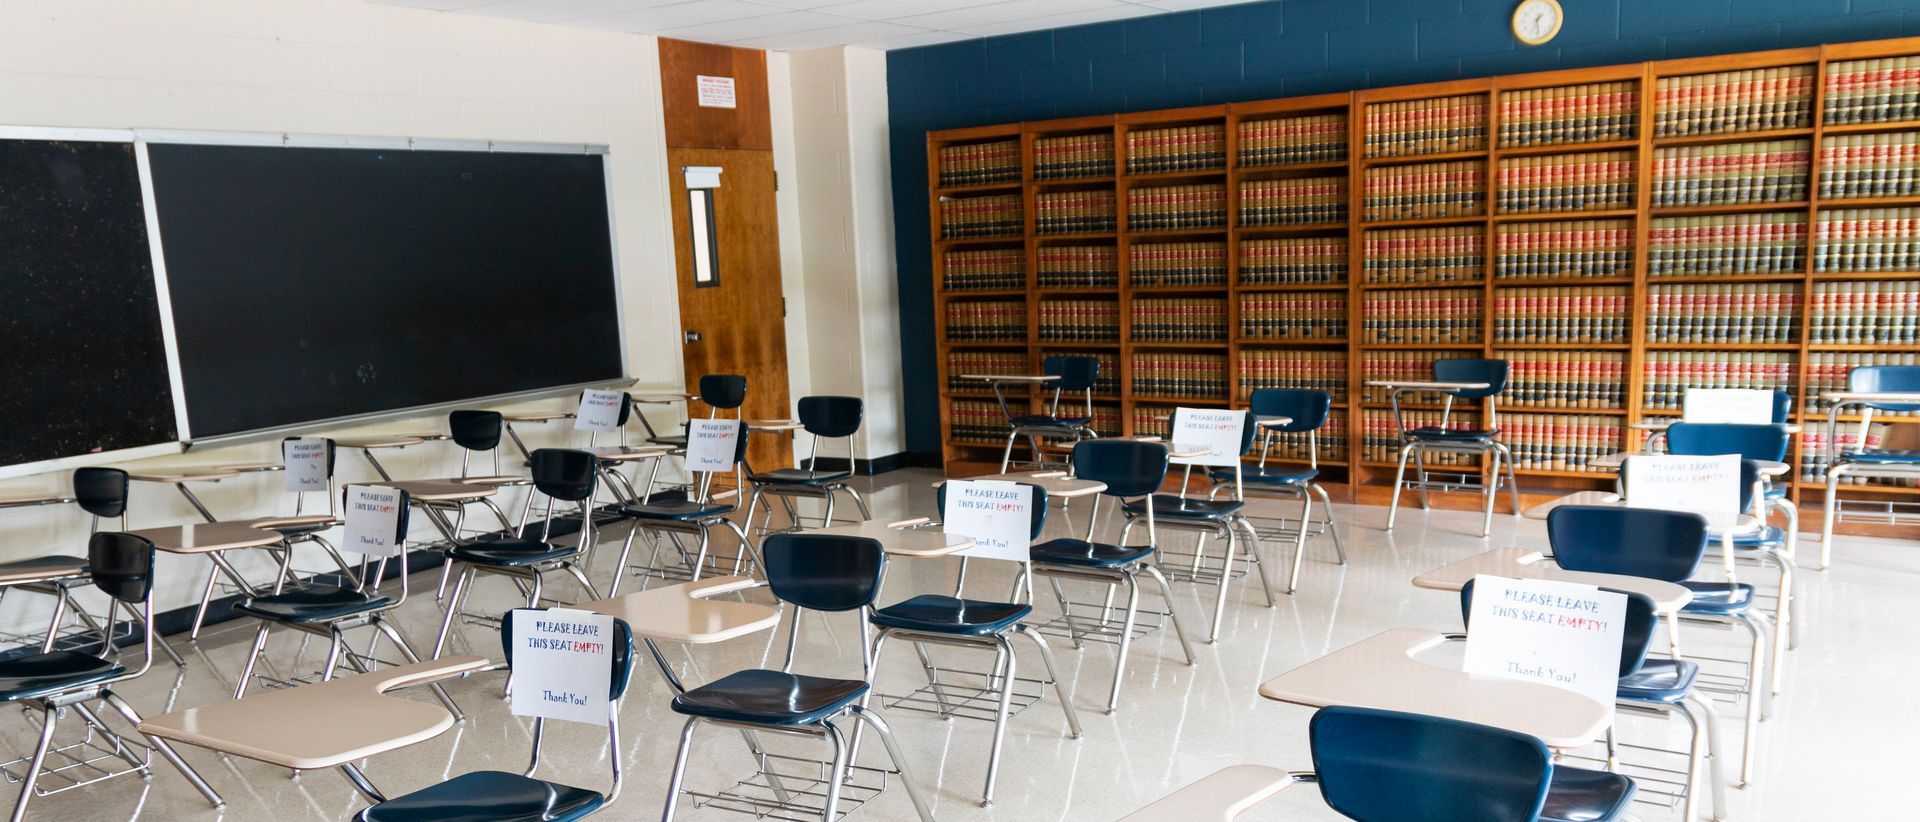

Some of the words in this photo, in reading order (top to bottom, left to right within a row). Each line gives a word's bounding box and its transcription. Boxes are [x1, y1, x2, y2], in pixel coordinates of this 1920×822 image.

[966, 489, 993, 498] PLEASE
[996, 491, 1018, 500] LEAVE
[976, 501, 994, 510] SEAT
[997, 503, 1024, 512] EMPTY!
[361, 536, 373, 544] Thank
[993, 539, 1008, 547] You!
[1505, 590, 1552, 606] PLEASE
[1557, 597, 1599, 613] LEAVE
[1492, 606, 1518, 619] THIS
[1522, 611, 1555, 624] SEAT
[1558, 616, 1607, 632] EMPTY!
[537, 622, 570, 634] PLEASE
[573, 624, 599, 636] LEAVE
[528, 638, 546, 649] THIS
[550, 640, 572, 650] SEAT
[574, 642, 603, 654] EMPTY!
[1507, 661, 1544, 678] Thank
[1549, 669, 1576, 683] You!
[544, 691, 567, 703] Thank
[570, 694, 587, 706] You!
